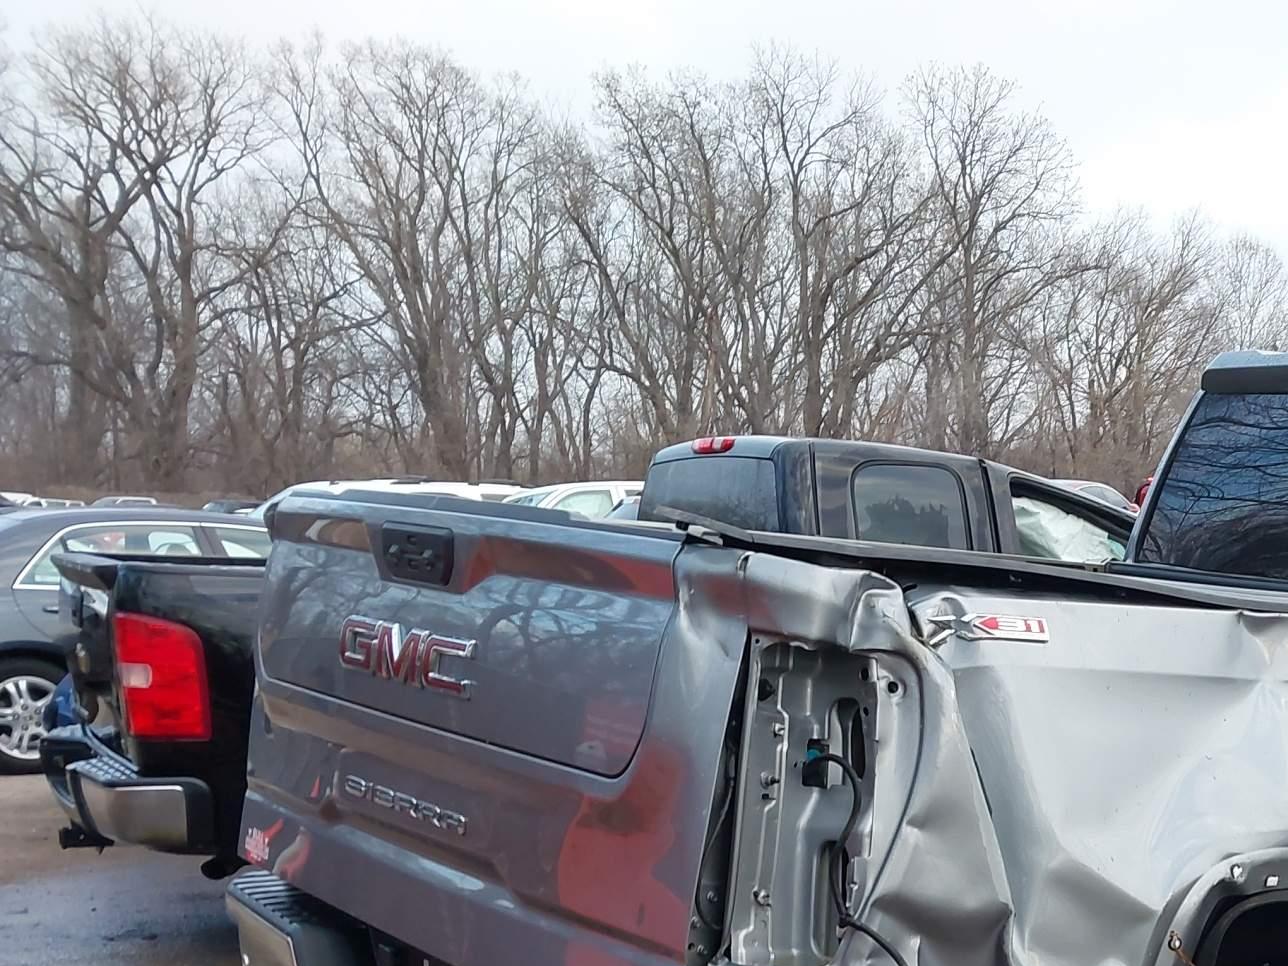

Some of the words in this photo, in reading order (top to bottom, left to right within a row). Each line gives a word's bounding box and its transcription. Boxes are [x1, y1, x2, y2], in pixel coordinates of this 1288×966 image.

[339, 614, 478, 701] GMC
[928, 613, 1049, 645] X31
[344, 774, 467, 836] SIERRA
